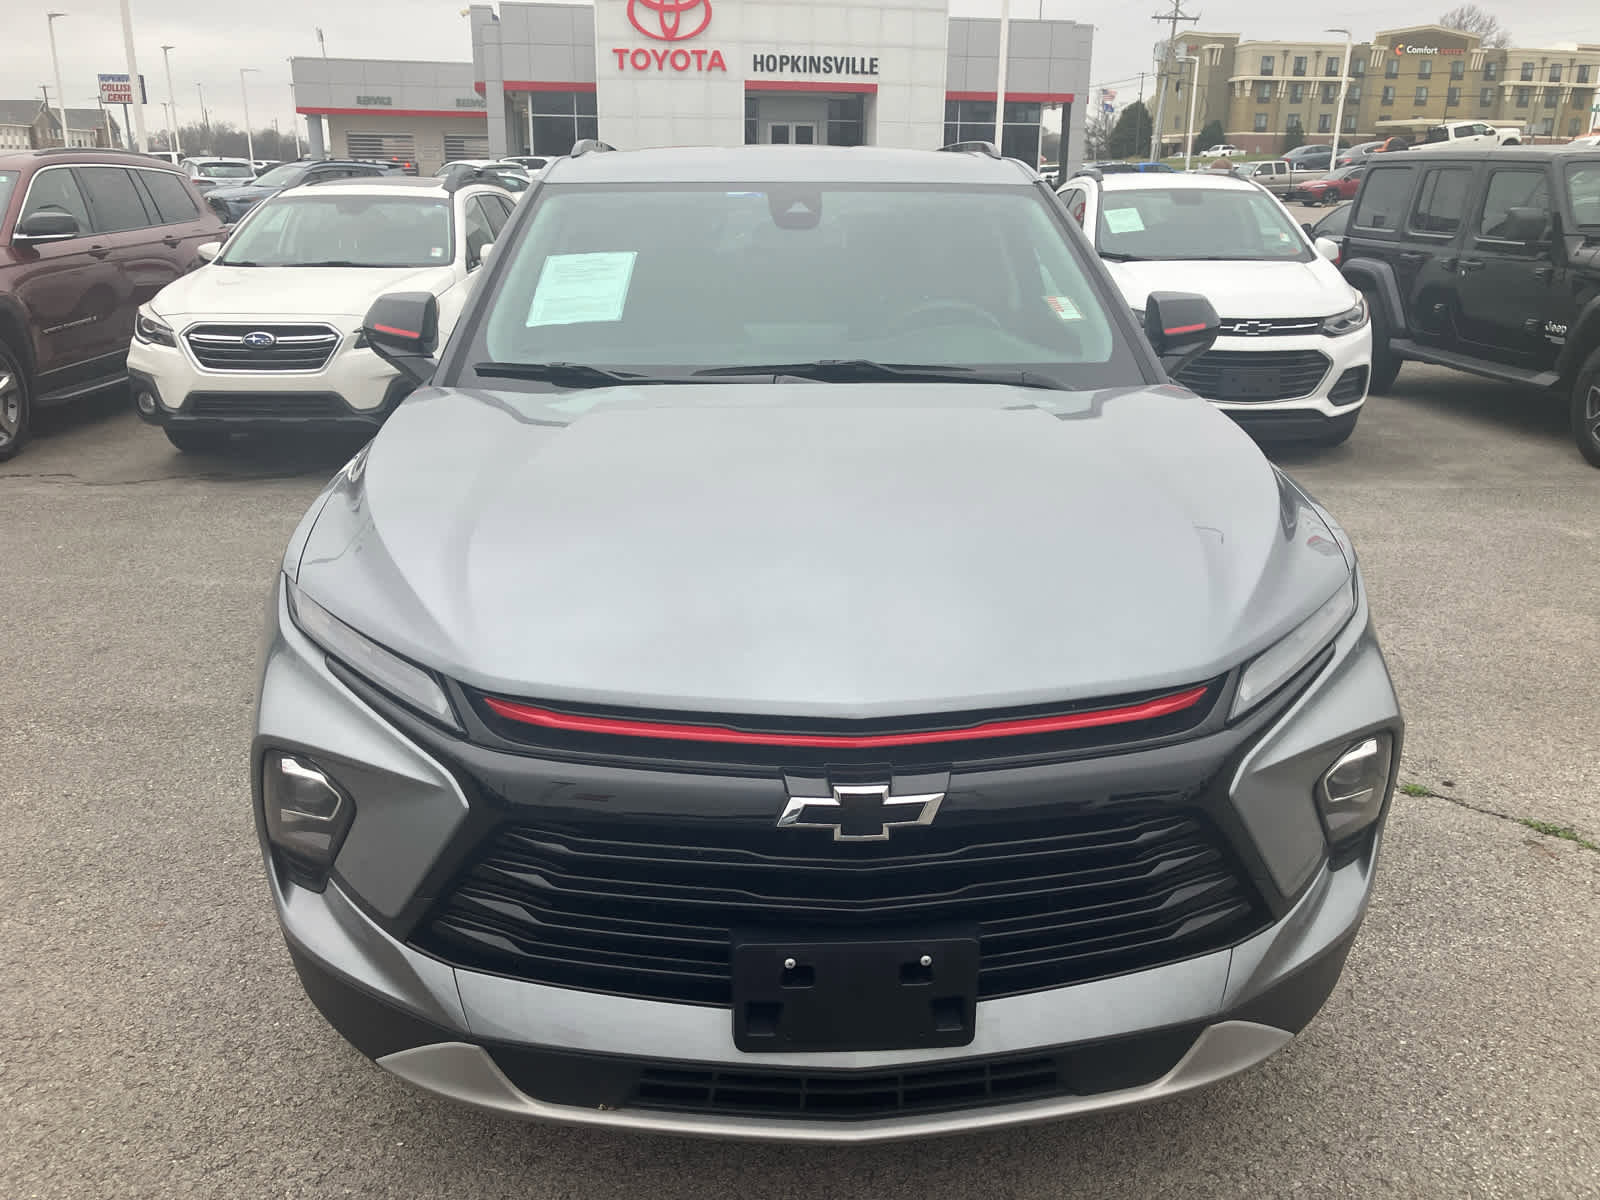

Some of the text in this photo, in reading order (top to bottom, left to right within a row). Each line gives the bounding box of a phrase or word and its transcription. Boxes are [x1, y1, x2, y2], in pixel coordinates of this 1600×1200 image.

[1406, 45, 1439, 55] Comfort
[612, 48, 727, 72] TOYOTA
[753, 54, 879, 75] HOPKINSVILLE
[101, 83, 131, 92] COLLISI
[107, 93, 133, 102] CENTE
[1545, 320, 1567, 335] Jeep
